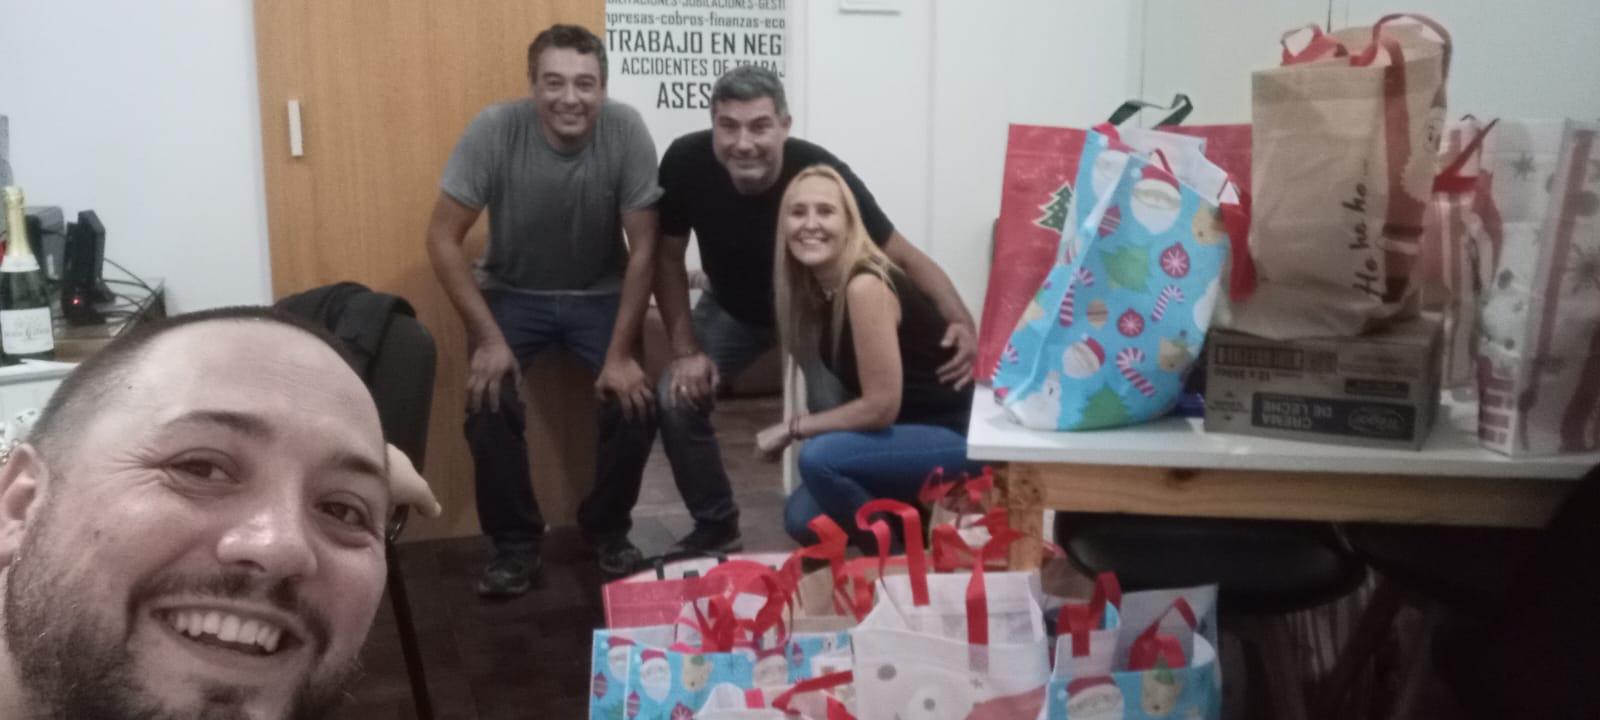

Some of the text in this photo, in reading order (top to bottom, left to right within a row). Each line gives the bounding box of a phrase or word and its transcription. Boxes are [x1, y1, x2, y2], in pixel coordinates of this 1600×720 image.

[606, 29, 782, 56] TRABAJO EN NEG
[621, 57, 708, 77] ACCIDENTES
[713, 59, 729, 77] DE
[1348, 220, 1370, 249] ho
[1352, 256, 1381, 298] Ho
[1263, 401, 1309, 416] LECHE
[1313, 404, 1333, 418] DE
[1262, 414, 1313, 430] CREMA
